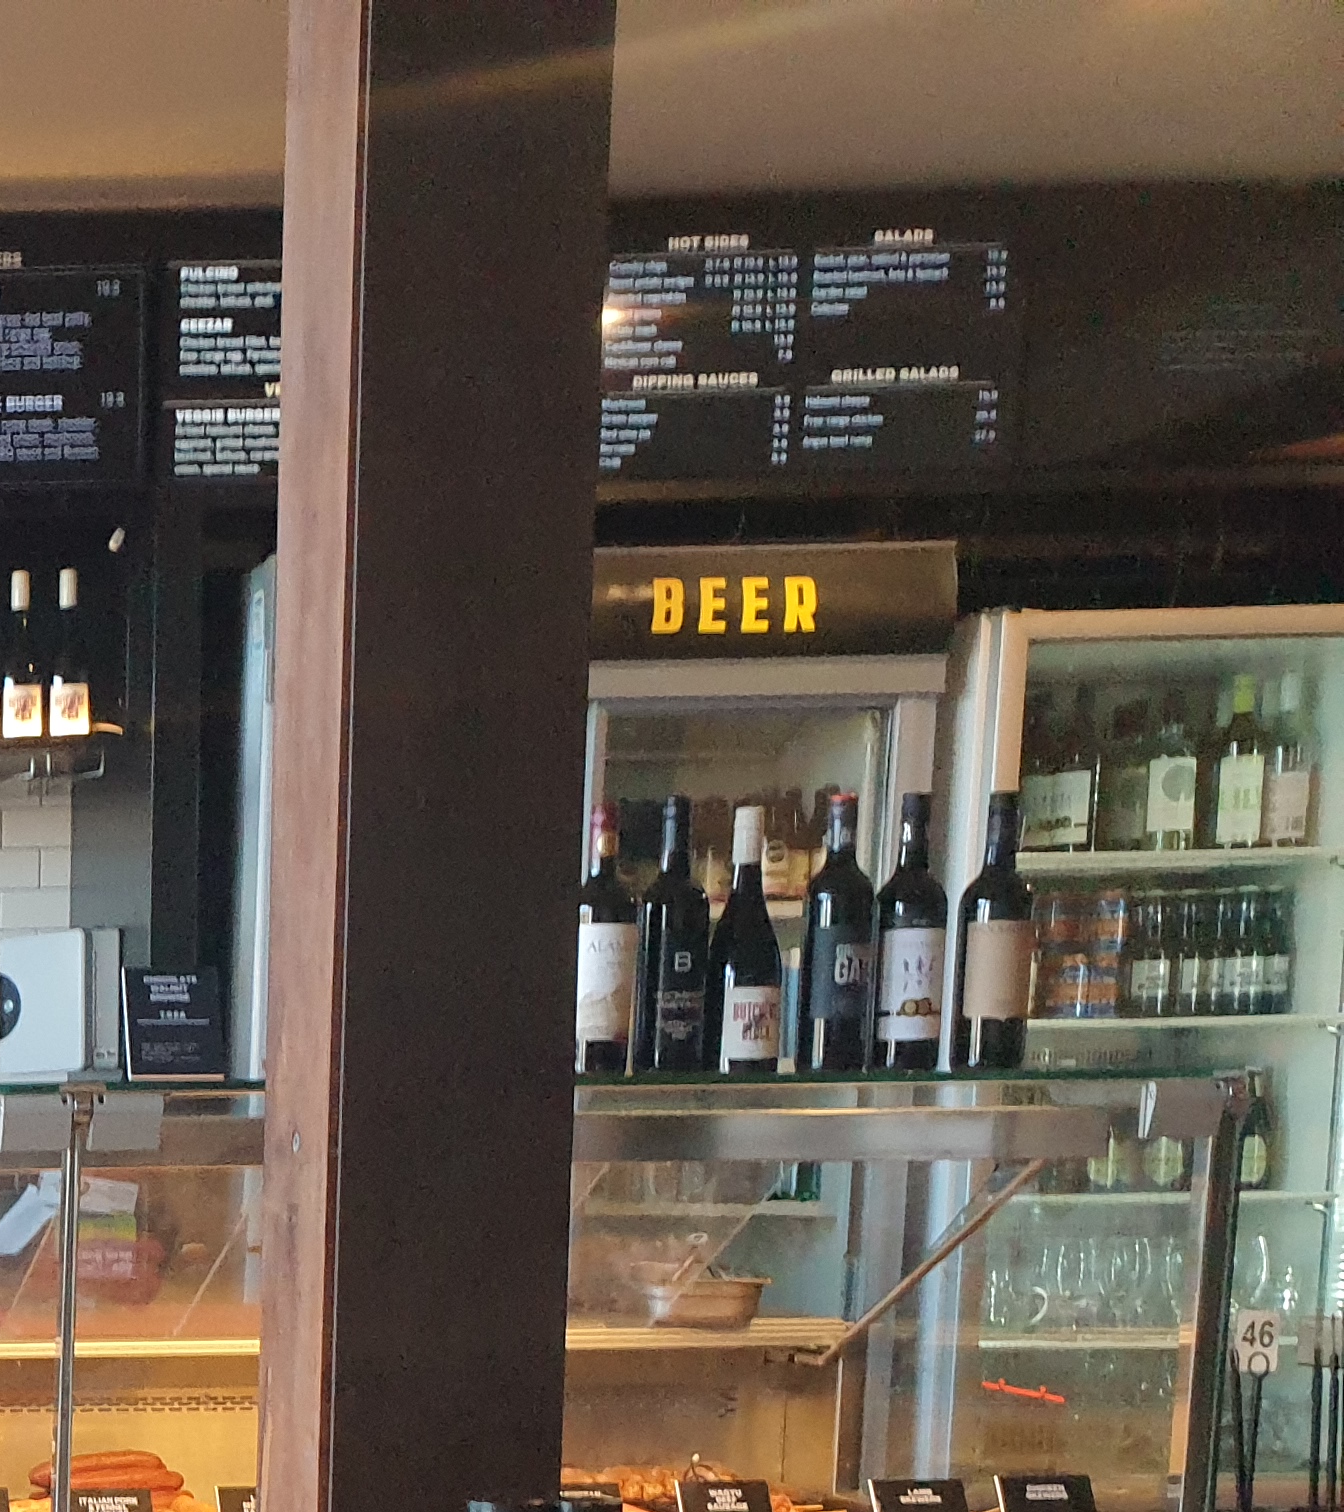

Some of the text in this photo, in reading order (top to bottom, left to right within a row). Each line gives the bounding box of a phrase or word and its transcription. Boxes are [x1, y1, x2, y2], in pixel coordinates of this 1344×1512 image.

[668, 235, 702, 251] HOT
[651, 575, 819, 635] BEER
[1241, 1319, 1275, 1348] 46
